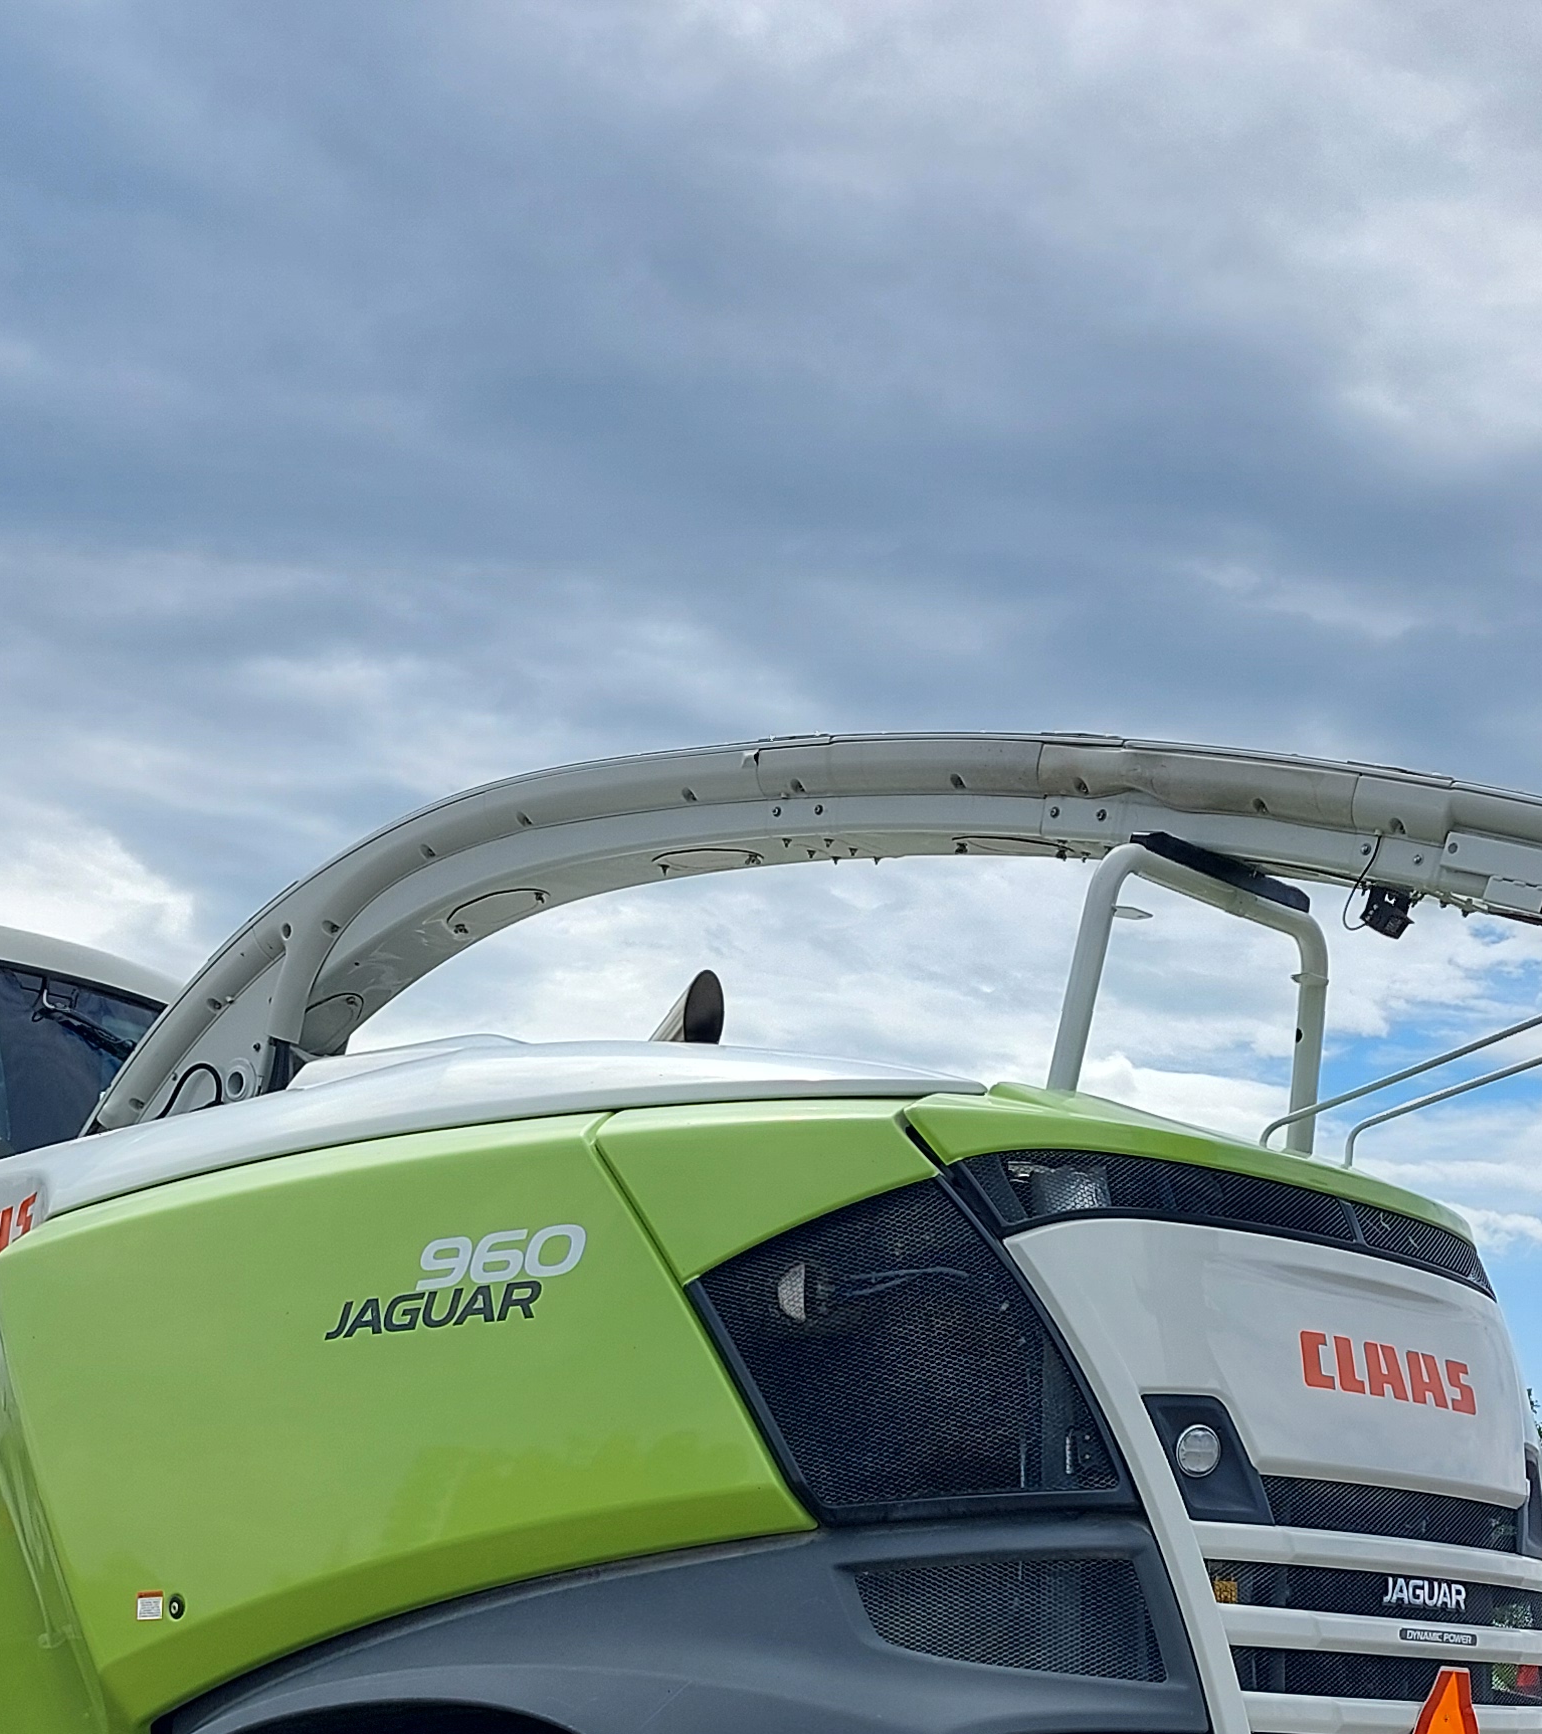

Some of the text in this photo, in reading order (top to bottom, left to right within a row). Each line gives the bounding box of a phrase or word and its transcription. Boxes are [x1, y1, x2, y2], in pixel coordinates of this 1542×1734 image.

[415, 1223, 587, 1291] 960
[324, 1280, 542, 1341] JAGUAR
[1300, 1330, 1477, 1416] CLAAS
[1382, 1576, 1467, 1611] JAGUAR
[1406, 1629, 1472, 1645] DYNAMIC POWER
